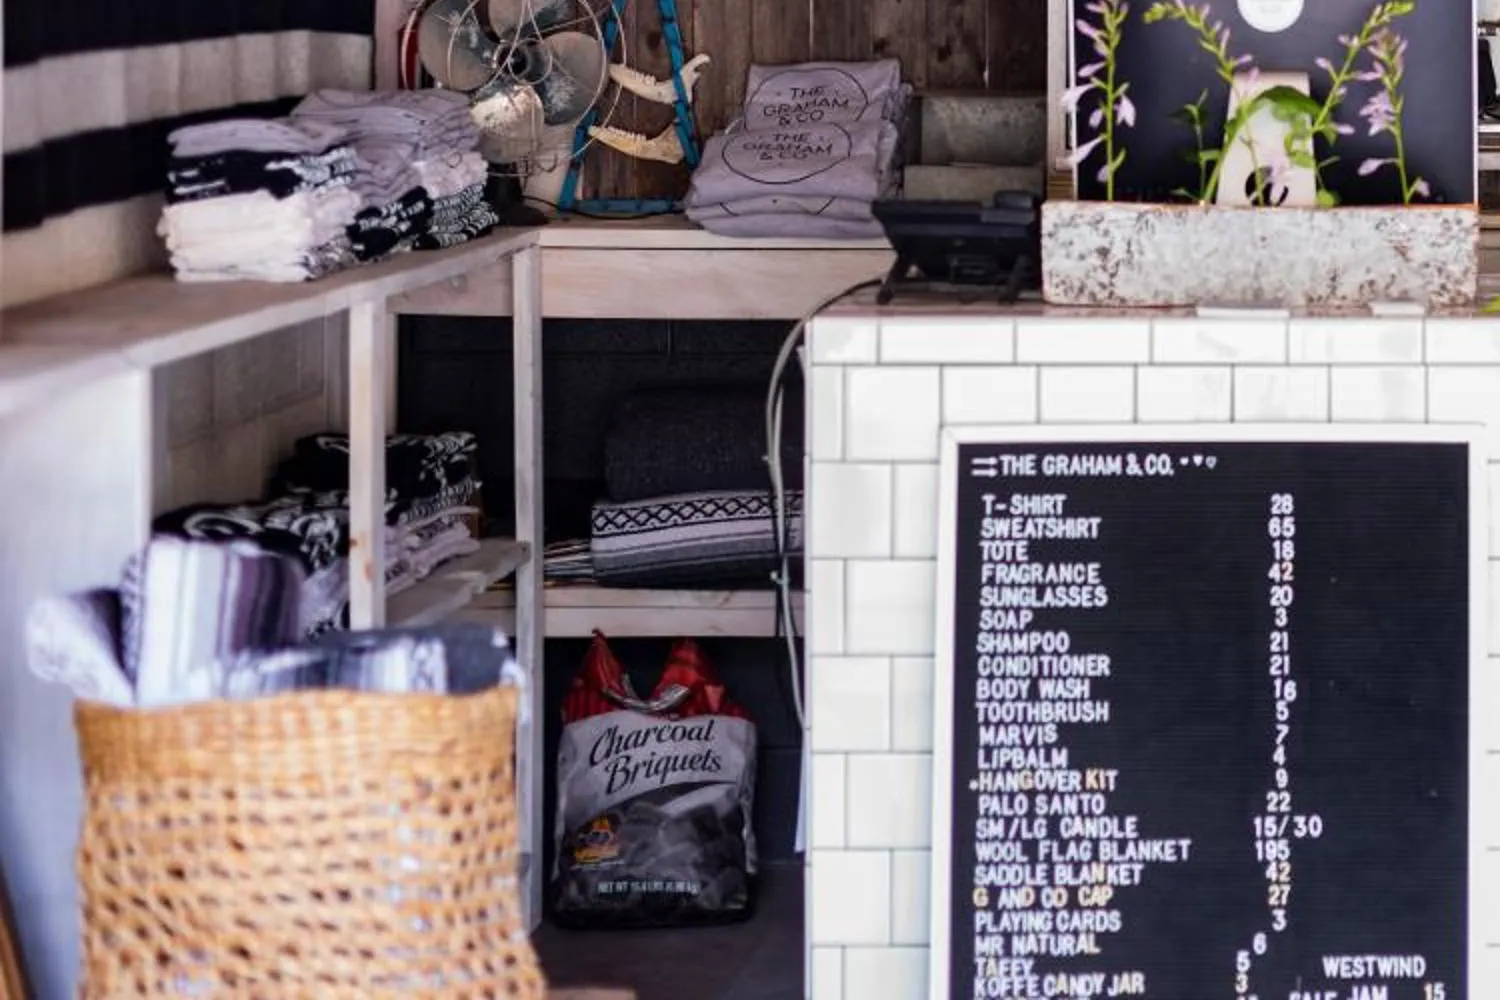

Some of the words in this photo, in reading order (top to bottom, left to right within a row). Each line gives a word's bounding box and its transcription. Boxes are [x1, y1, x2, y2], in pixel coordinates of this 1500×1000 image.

[790, 86, 826, 98] THE
[763, 98, 849, 118] GRAHAM
[773, 132, 811, 142] THE
[743, 142, 832, 155] GRAHAM
[1000, 455, 1037, 475] THE
[1042, 455, 1122, 475] GRAHAM
[1126, 455, 1143, 476] &
[1271, 494, 1293, 514] 28
[981, 518, 1101, 539] SWEATSHIRT
[1268, 517, 1295, 537] 65
[979, 541, 1028, 560] TOTE
[1273, 541, 1294, 560] 18
[982, 564, 1100, 584] FRAGRANCE
[1268, 563, 1293, 582] 42
[980, 586, 1108, 607] SUNGLASSES
[1270, 586, 1293, 605] 20
[979, 609, 1033, 630] SOAP
[1275, 608, 1288, 627] 3
[976, 632, 1070, 653] SHAMPOO
[1270, 632, 1288, 651] 21
[978, 655, 1110, 676] CONDITIONER
[1270, 656, 1289, 675] 21
[976, 678, 1030, 700] BODY
[1038, 678, 1090, 699] WASH
[1274, 678, 1296, 702] 16
[975, 701, 1109, 723] TOOTHBRUSH
[1276, 702, 1289, 721] 5
[589, 719, 715, 766] Charcoal
[979, 723, 1058, 745] MARVIS
[1276, 724, 1289, 745] 7
[978, 747, 1068, 769] LIPBALM
[1273, 747, 1285, 766] 4
[605, 749, 721, 794] Briquets
[978, 770, 1082, 791] HANGOVER
[1086, 770, 1118, 791] KIT
[1276, 770, 1288, 788] 9
[978, 794, 1028, 815] PALO
[1035, 794, 1105, 814] SANTO
[1266, 793, 1291, 812] 22
[1060, 816, 1138, 837] CANDLE
[975, 839, 1028, 861] WOOL
[1038, 839, 1092, 861] FLAG
[1099, 838, 1191, 861] BLANKET
[1255, 839, 1290, 861] 195
[974, 863, 1048, 885] SADDLE
[1054, 863, 1144, 884] BLANKET
[1266, 864, 1291, 882] 42
[973, 887, 989, 907] G
[998, 887, 1035, 909] AND
[1040, 887, 1068, 907] CO
[1078, 885, 1113, 906] CAP
[1268, 885, 1291, 906] 27
[974, 910, 1053, 933] PLAYING
[1056, 910, 1122, 932] CARDS
[1272, 910, 1286, 931] 3
[974, 934, 1004, 957] MR
[1012, 934, 1101, 956] NATURAL
[1253, 933, 1267, 955] 6
[974, 958, 1036, 977] TAFFY
[1236, 951, 1251, 970] 5
[1322, 955, 1426, 978] WESTWIND
[974, 976, 1041, 997] KOFFE
[1041, 972, 1105, 997] CANDY
[1107, 972, 1145, 995] JAR
[1235, 974, 1248, 993] 3
[1424, 982, 1445, 1000] 15
